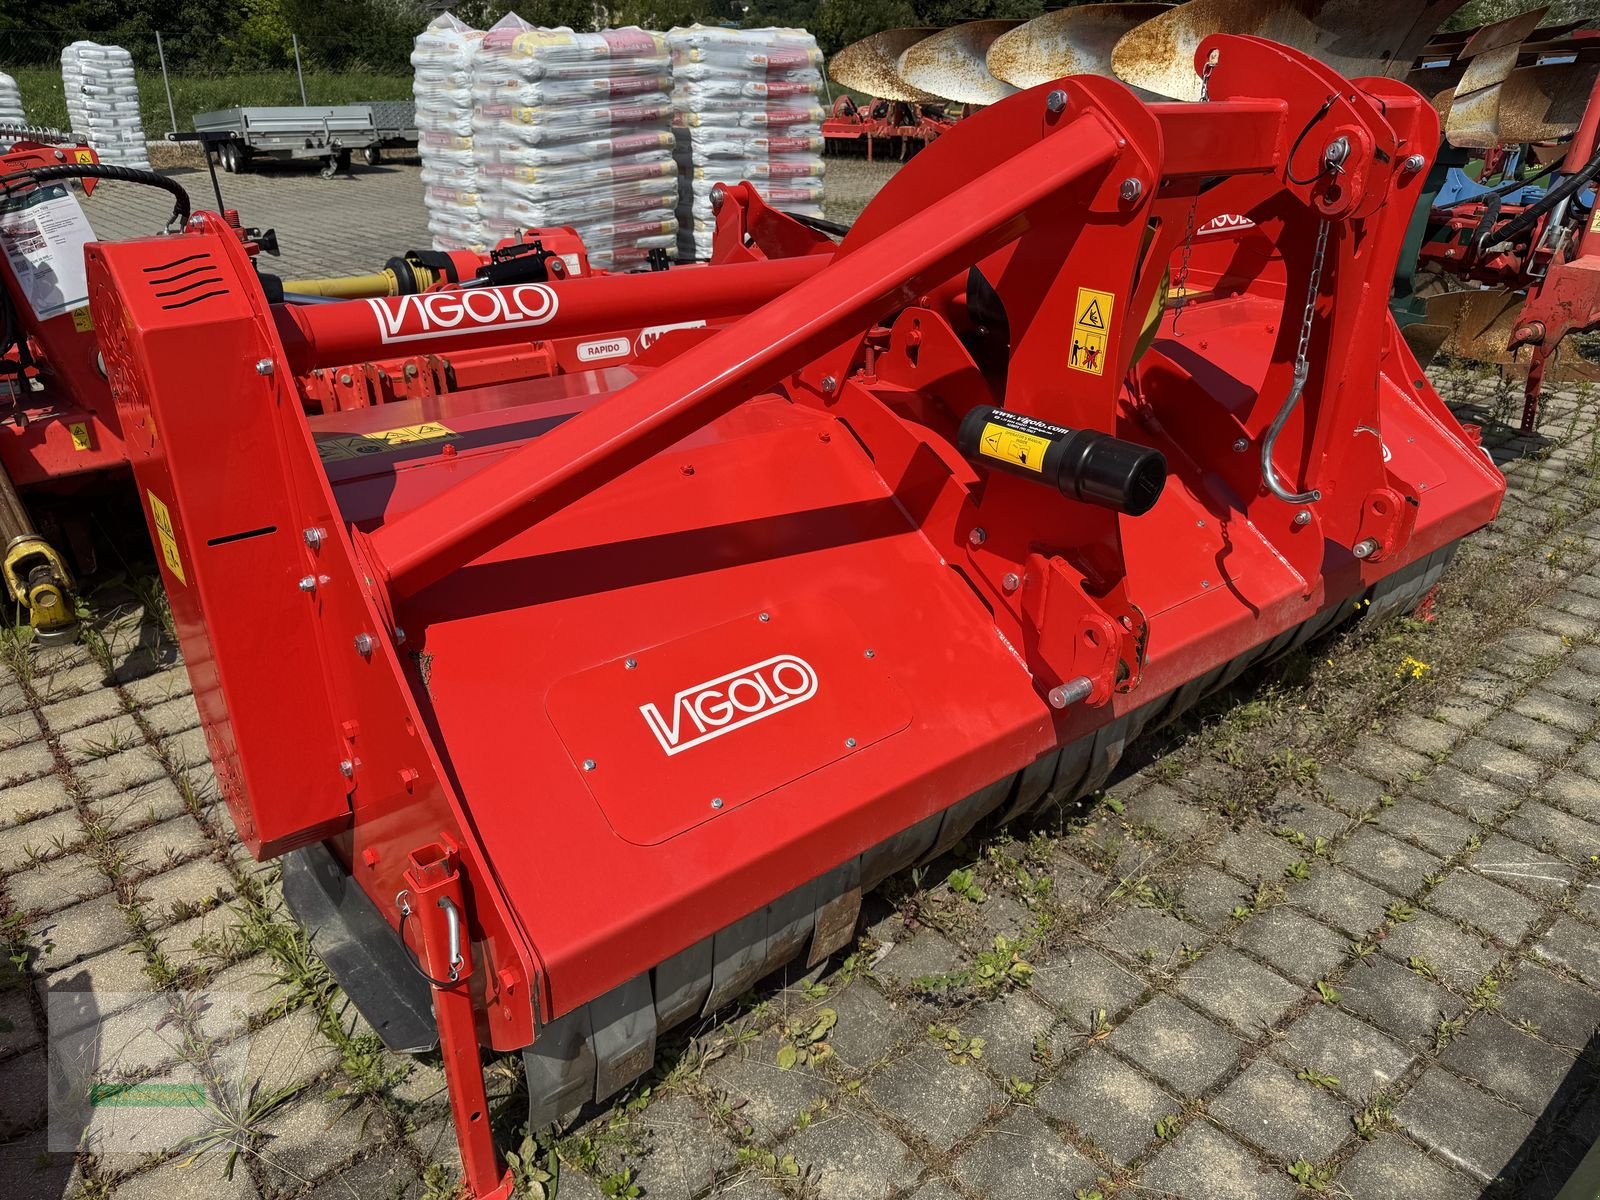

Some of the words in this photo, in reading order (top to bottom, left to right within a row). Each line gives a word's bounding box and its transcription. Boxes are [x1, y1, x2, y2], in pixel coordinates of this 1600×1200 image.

[366, 283, 560, 344] VIGOLO
[587, 343, 620, 356] RAPIDO
[991, 408, 1070, 434] www.vigolo.com
[639, 654, 819, 757] VIGOLO
